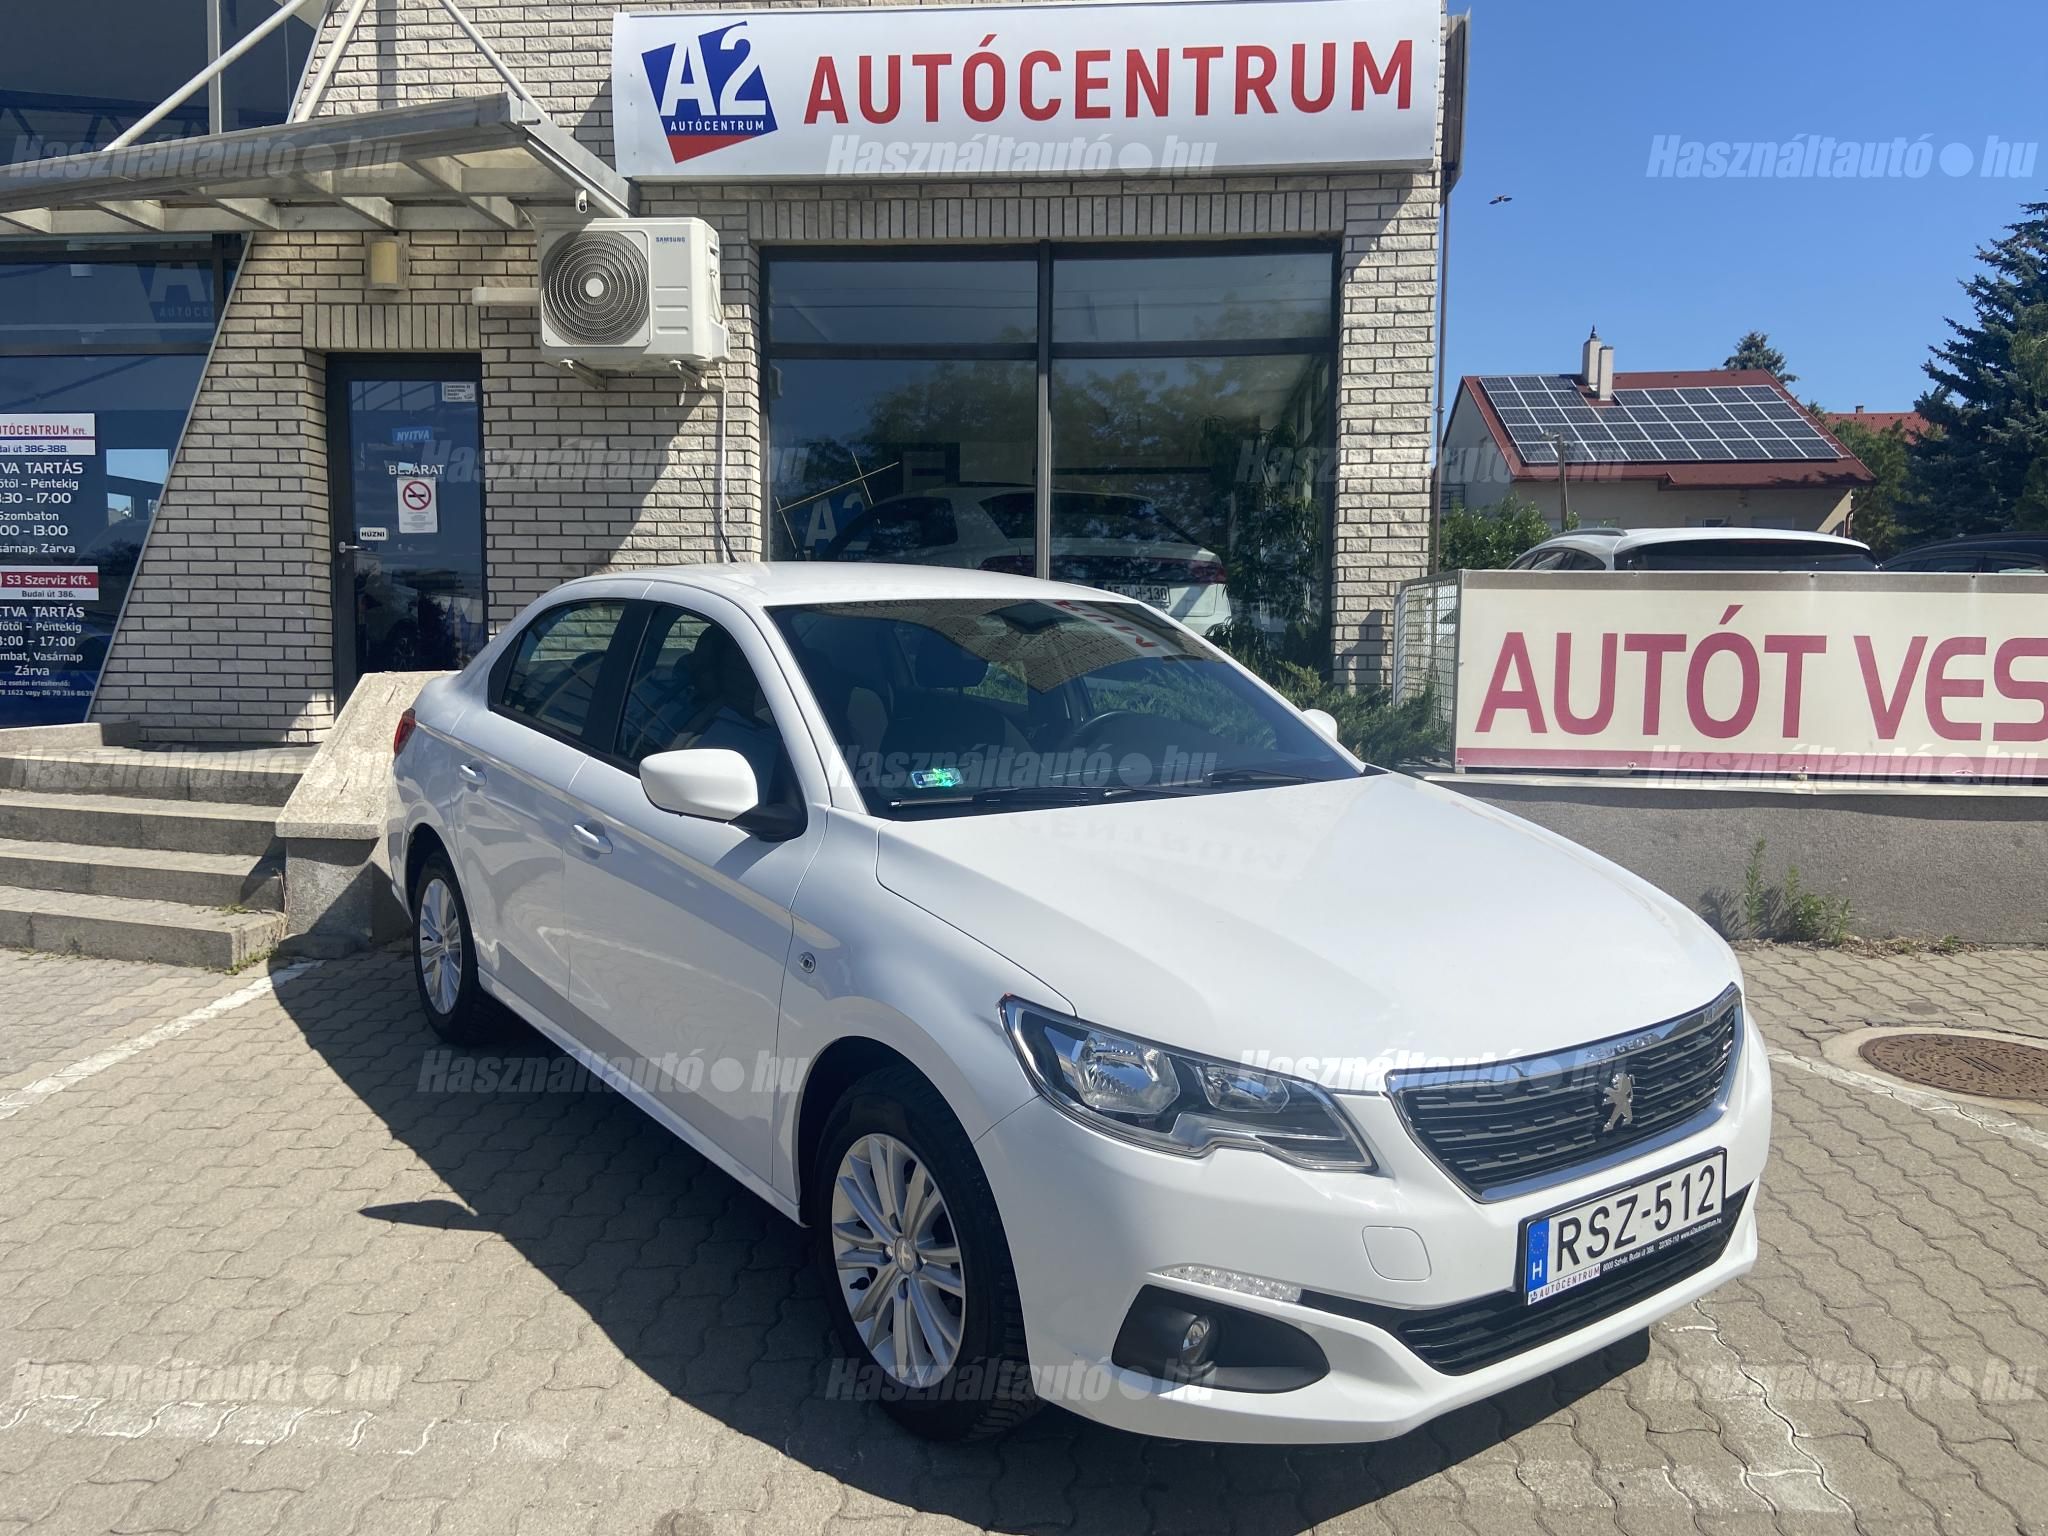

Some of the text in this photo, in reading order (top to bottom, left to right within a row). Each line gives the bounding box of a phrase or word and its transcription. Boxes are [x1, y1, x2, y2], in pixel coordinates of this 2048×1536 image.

[660, 25, 766, 116] A2
[804, 34, 1413, 124] AUTÓCENTRUM
[671, 118, 764, 131] AUTÓCENTRUM
[0, 422, 70, 436] TÓCENTRUM
[397, 430, 430, 441] NYITVA
[25, 459, 84, 475] TARTÁS
[31, 478, 79, 491] Péntekig
[0, 492, 23, 504] :30
[37, 492, 72, 504] 17:00
[34, 525, 69, 536] 13:00
[41, 543, 76, 553] Zárva
[6, 575, 92, 585] S3 Szerviz Kft.
[22, 590, 76, 599] Budai út 386.
[0, 603, 85, 618] TVA TARTÁS
[36, 622, 82, 633] Péntekig
[40, 636, 76, 647] 17:00
[34, 651, 84, 662] Vasárnap
[14, 664, 50, 676] Zárva
[1475, 604, 1828, 740] AUTÓT
[25, 690, 41, 699] vagy
[1557, 1165, 1715, 1271] RSZ-512
[1532, 1260, 1542, 1280] H
[1539, 1265, 1600, 1298] AUTÓCENTRUM
